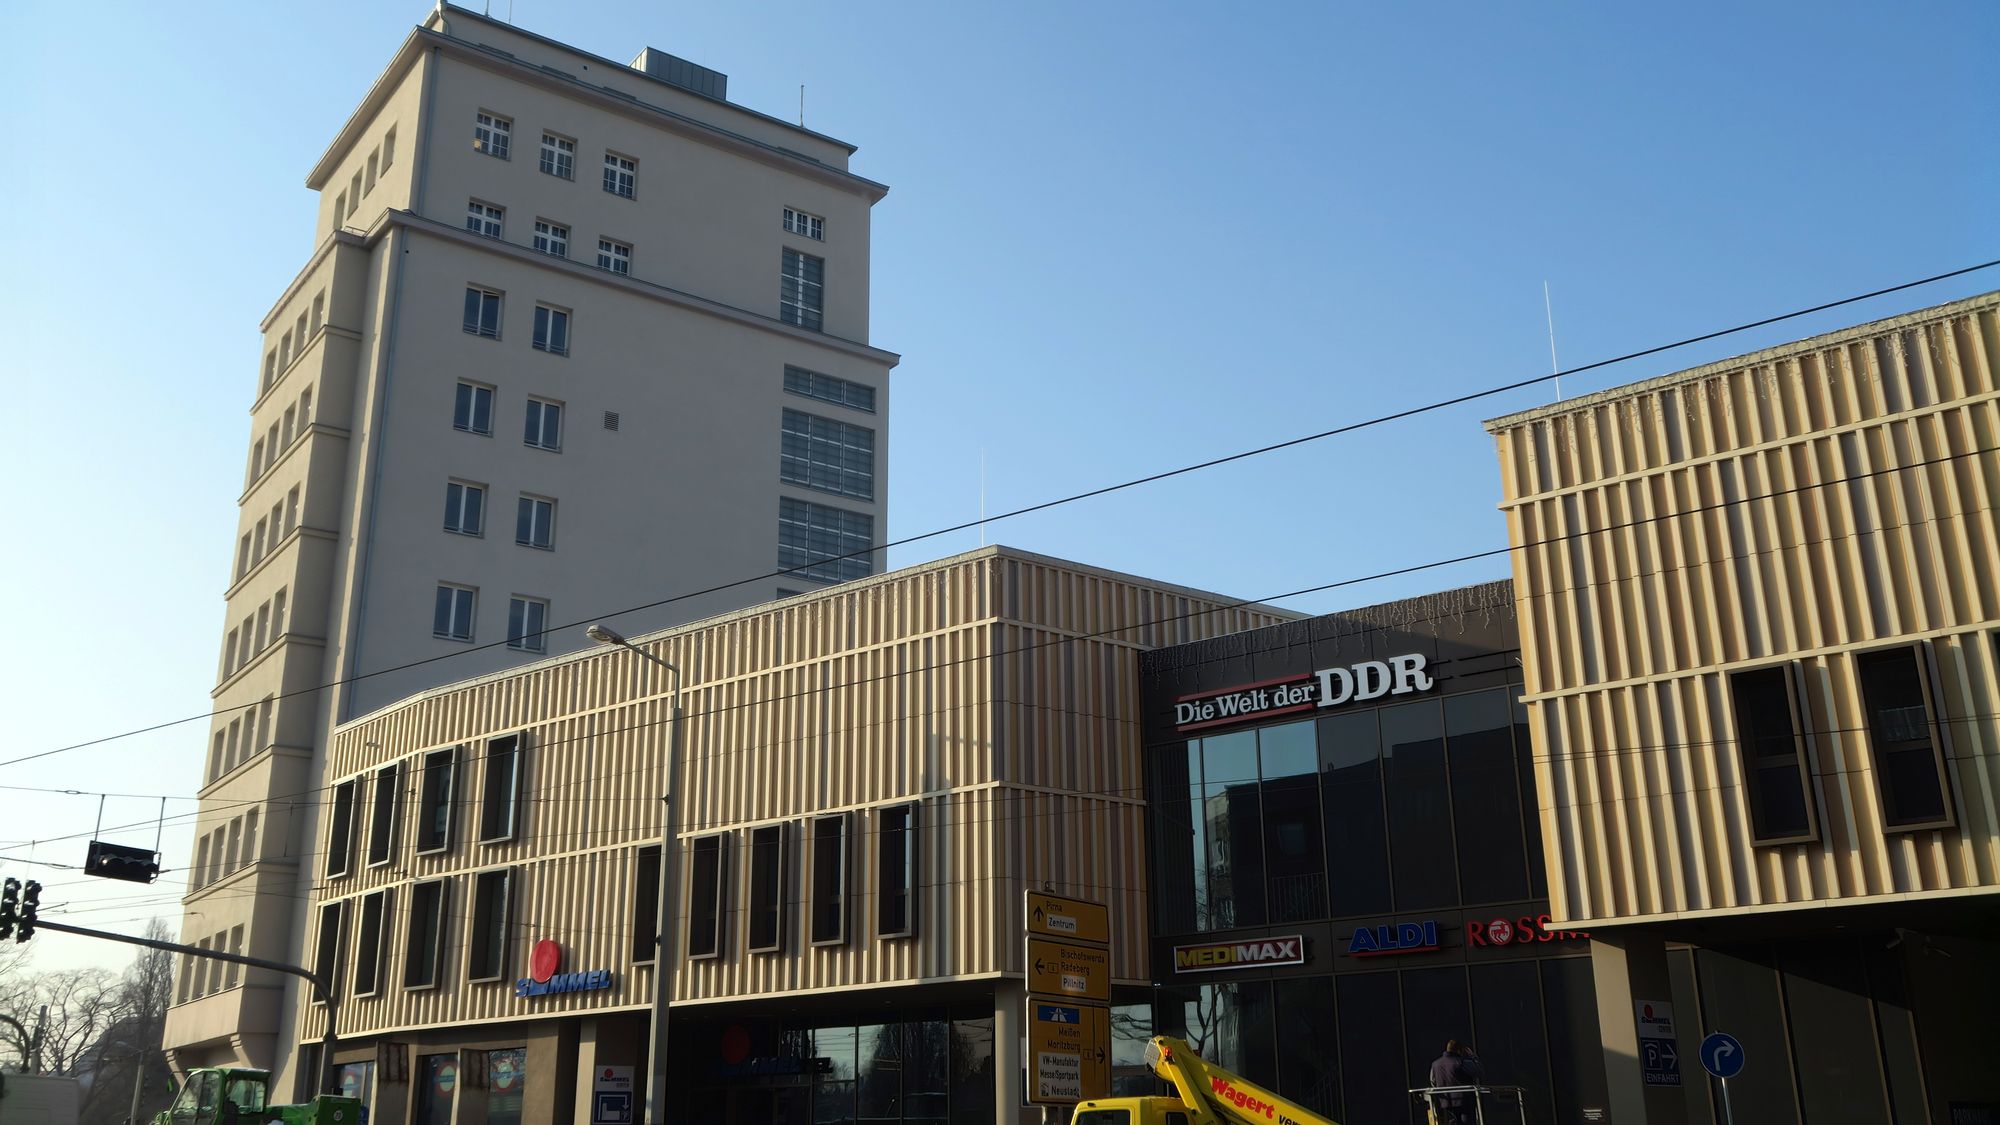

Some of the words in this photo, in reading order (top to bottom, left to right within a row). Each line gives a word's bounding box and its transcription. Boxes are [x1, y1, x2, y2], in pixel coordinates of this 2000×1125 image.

[1175, 701, 1214, 725] Die
[1216, 689, 1269, 716] Welt
[1274, 684, 1315, 708] der
[1315, 653, 1433, 708] DDR
[1048, 917, 1075, 930] Zentrum
[1348, 920, 1437, 953] ALDI
[1060, 948, 1105, 964] Bischofswerda
[1177, 940, 1296, 968] MEDIMAX
[1061, 961, 1090, 976] Radeberg
[1063, 978, 1085, 989] Pillnitz
[1047, 1040, 1081, 1053] Moritzburg
[1645, 1073, 1680, 1083] EINFAHRT
[1212, 1076, 1275, 1119] Wagert
